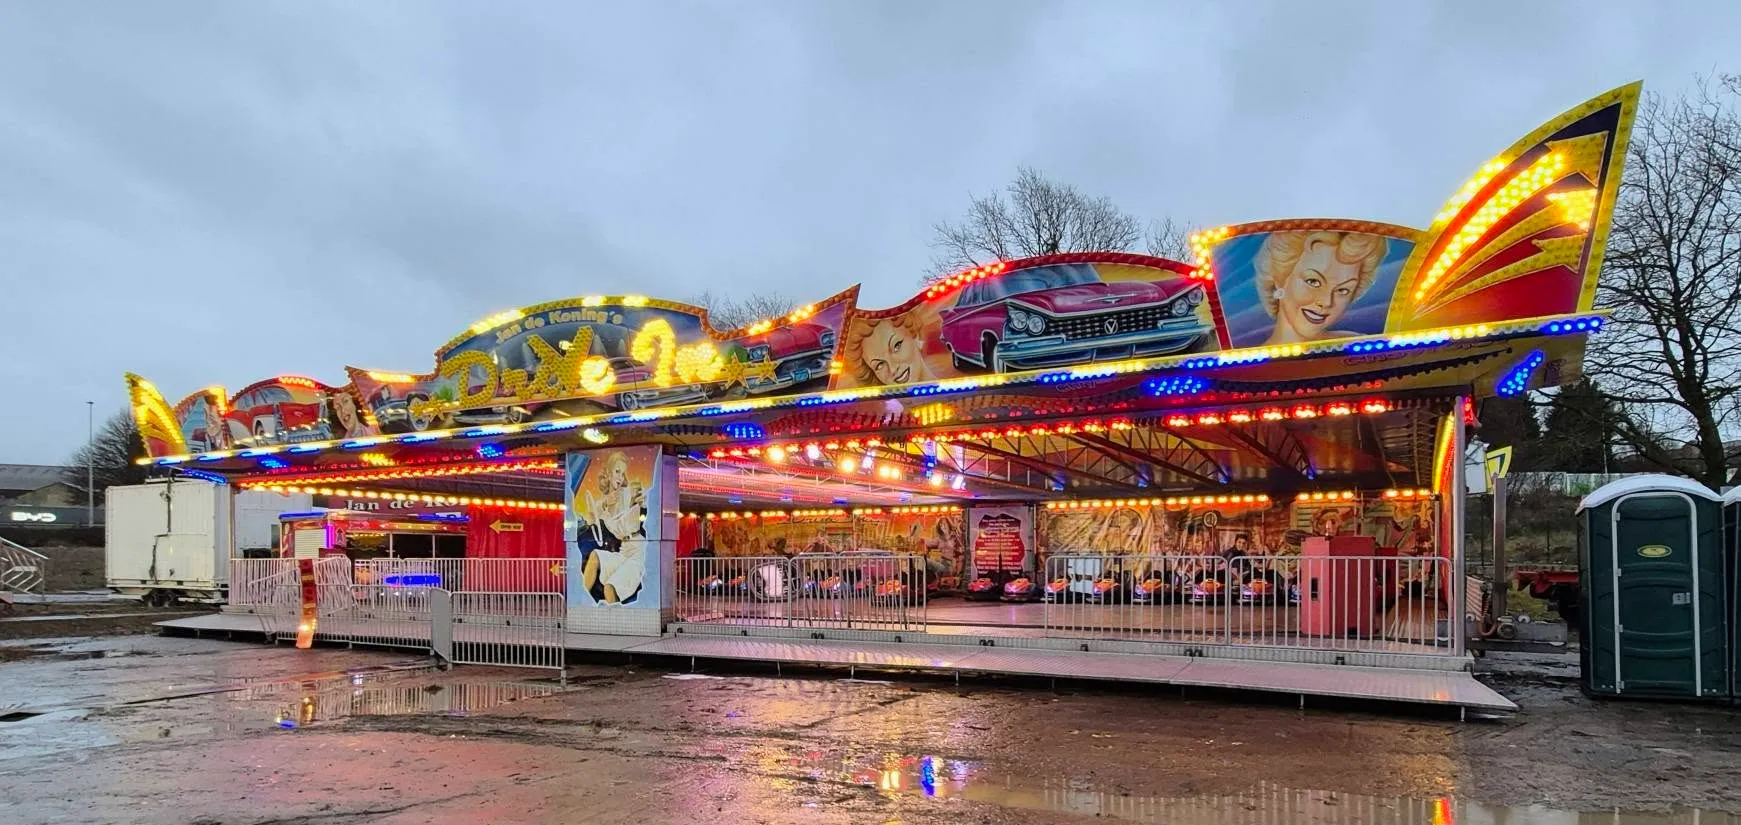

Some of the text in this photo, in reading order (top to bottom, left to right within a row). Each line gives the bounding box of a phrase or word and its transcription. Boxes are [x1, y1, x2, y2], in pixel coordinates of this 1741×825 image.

[496, 308, 624, 343] Jan de Koning's
[12, 511, 57, 522] BYD
